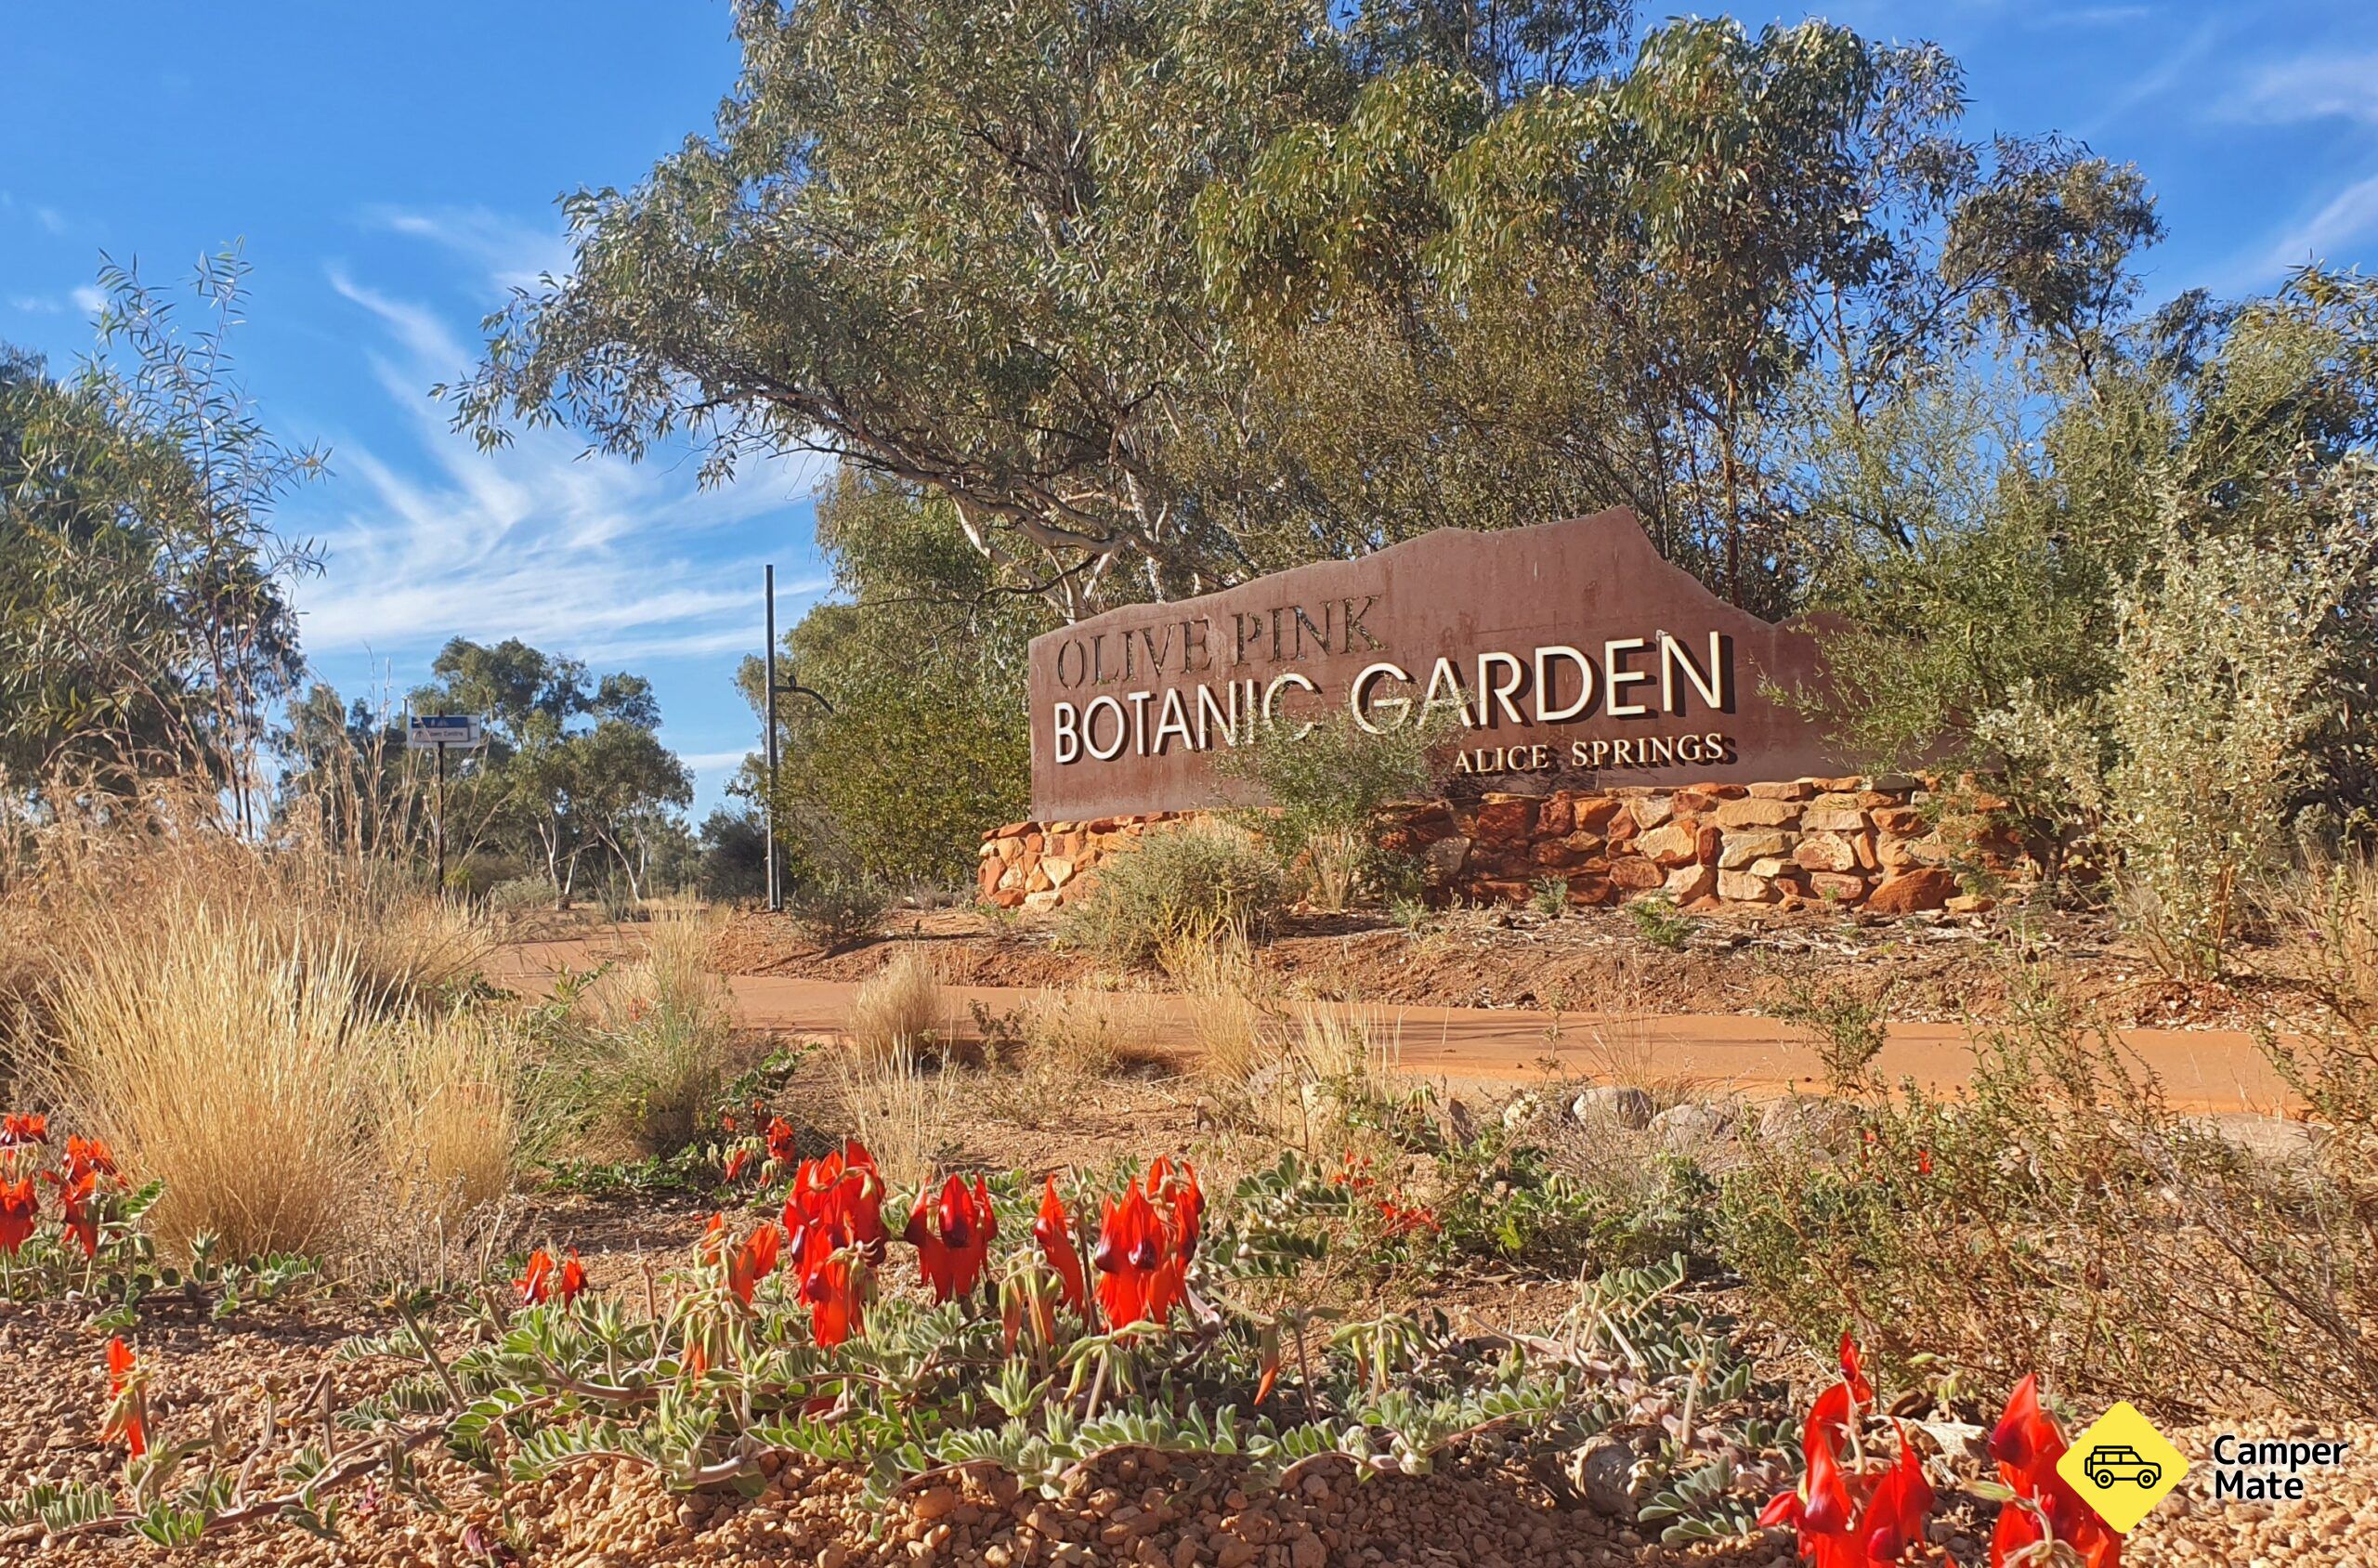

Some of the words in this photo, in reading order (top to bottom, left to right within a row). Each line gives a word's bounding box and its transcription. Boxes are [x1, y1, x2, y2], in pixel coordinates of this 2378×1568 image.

[1057, 618, 1213, 689] OLIVE
[1232, 595, 1389, 667] PINK
[1054, 672, 1314, 763] BOTANIC
[1351, 631, 1721, 734] GARDEN
[1455, 743, 1548, 774] ALICE
[1572, 732, 1724, 767] SPRINGS
